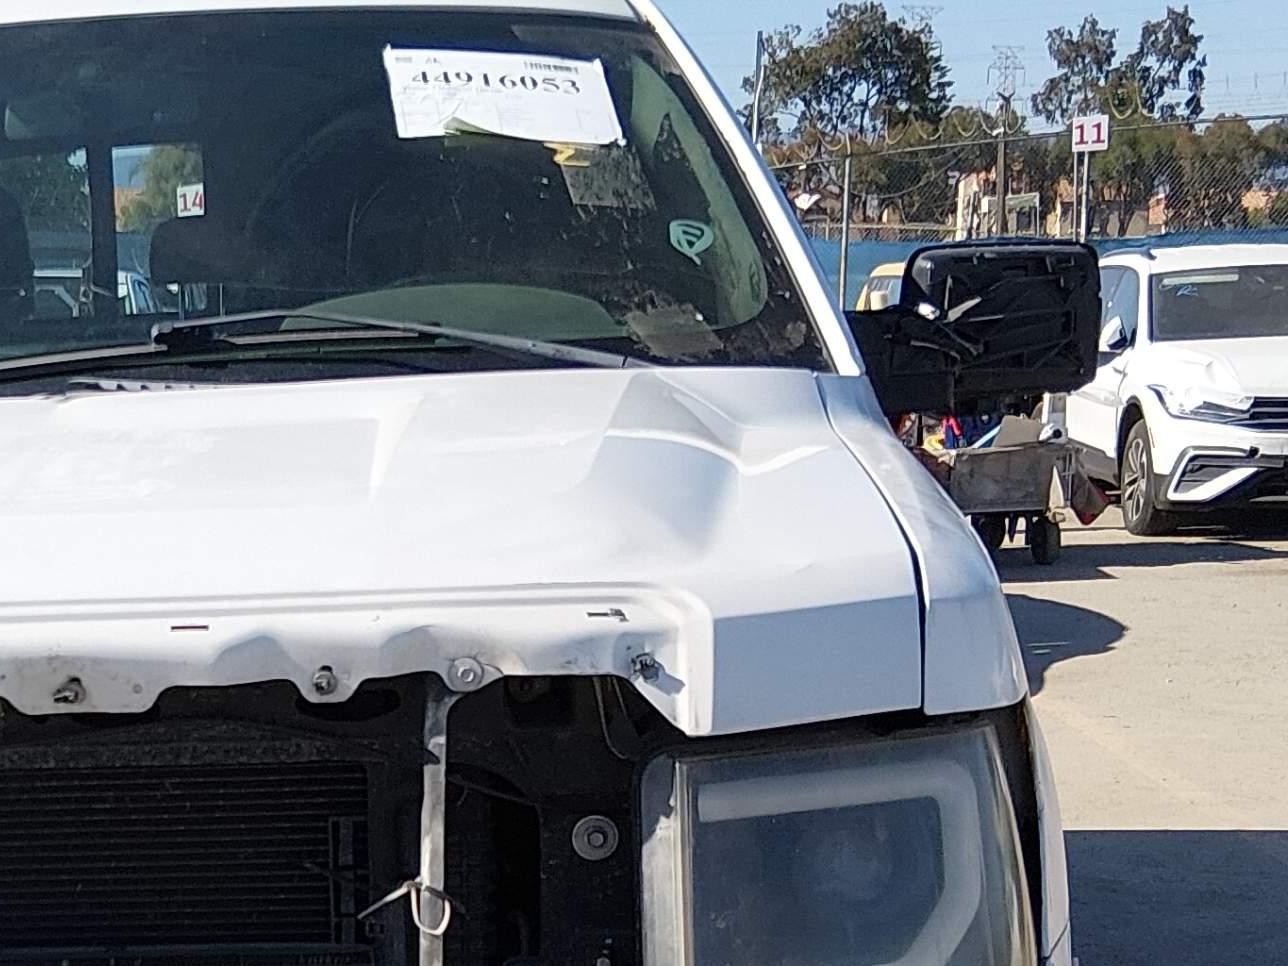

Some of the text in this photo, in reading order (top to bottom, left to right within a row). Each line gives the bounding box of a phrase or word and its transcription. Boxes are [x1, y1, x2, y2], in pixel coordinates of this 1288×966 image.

[411, 70, 581, 95] 44916053
[1074, 121, 1106, 145] 11
[179, 191, 204, 212] 14
